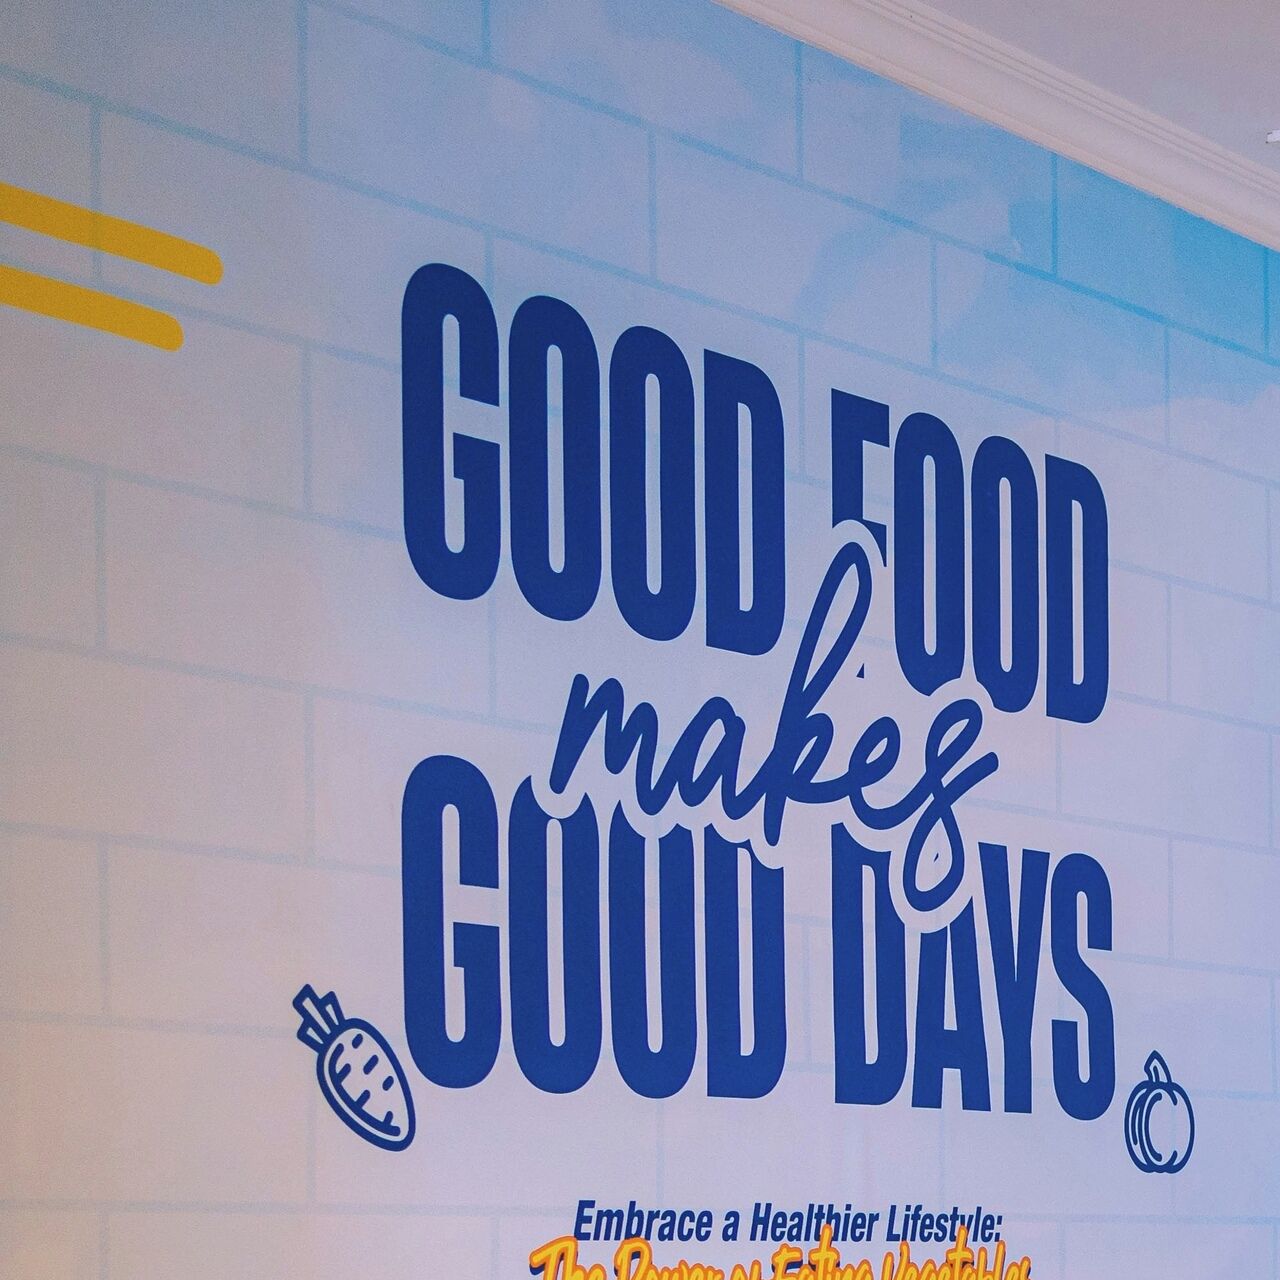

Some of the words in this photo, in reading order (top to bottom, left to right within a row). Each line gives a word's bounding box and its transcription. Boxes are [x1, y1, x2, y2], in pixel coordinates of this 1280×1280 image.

[401, 263, 786, 656] GOOD
[831, 389, 1109, 723] FOOD
[550, 542, 998, 912] makes
[401, 754, 787, 1099] GOOD
[831, 821, 1115, 1121] DAYS
[574, 1200, 713, 1242] Embrace
[721, 1213, 740, 1242] a
[749, 1202, 879, 1242] Healthier
[886, 1204, 1003, 1242] Lifestyle:
